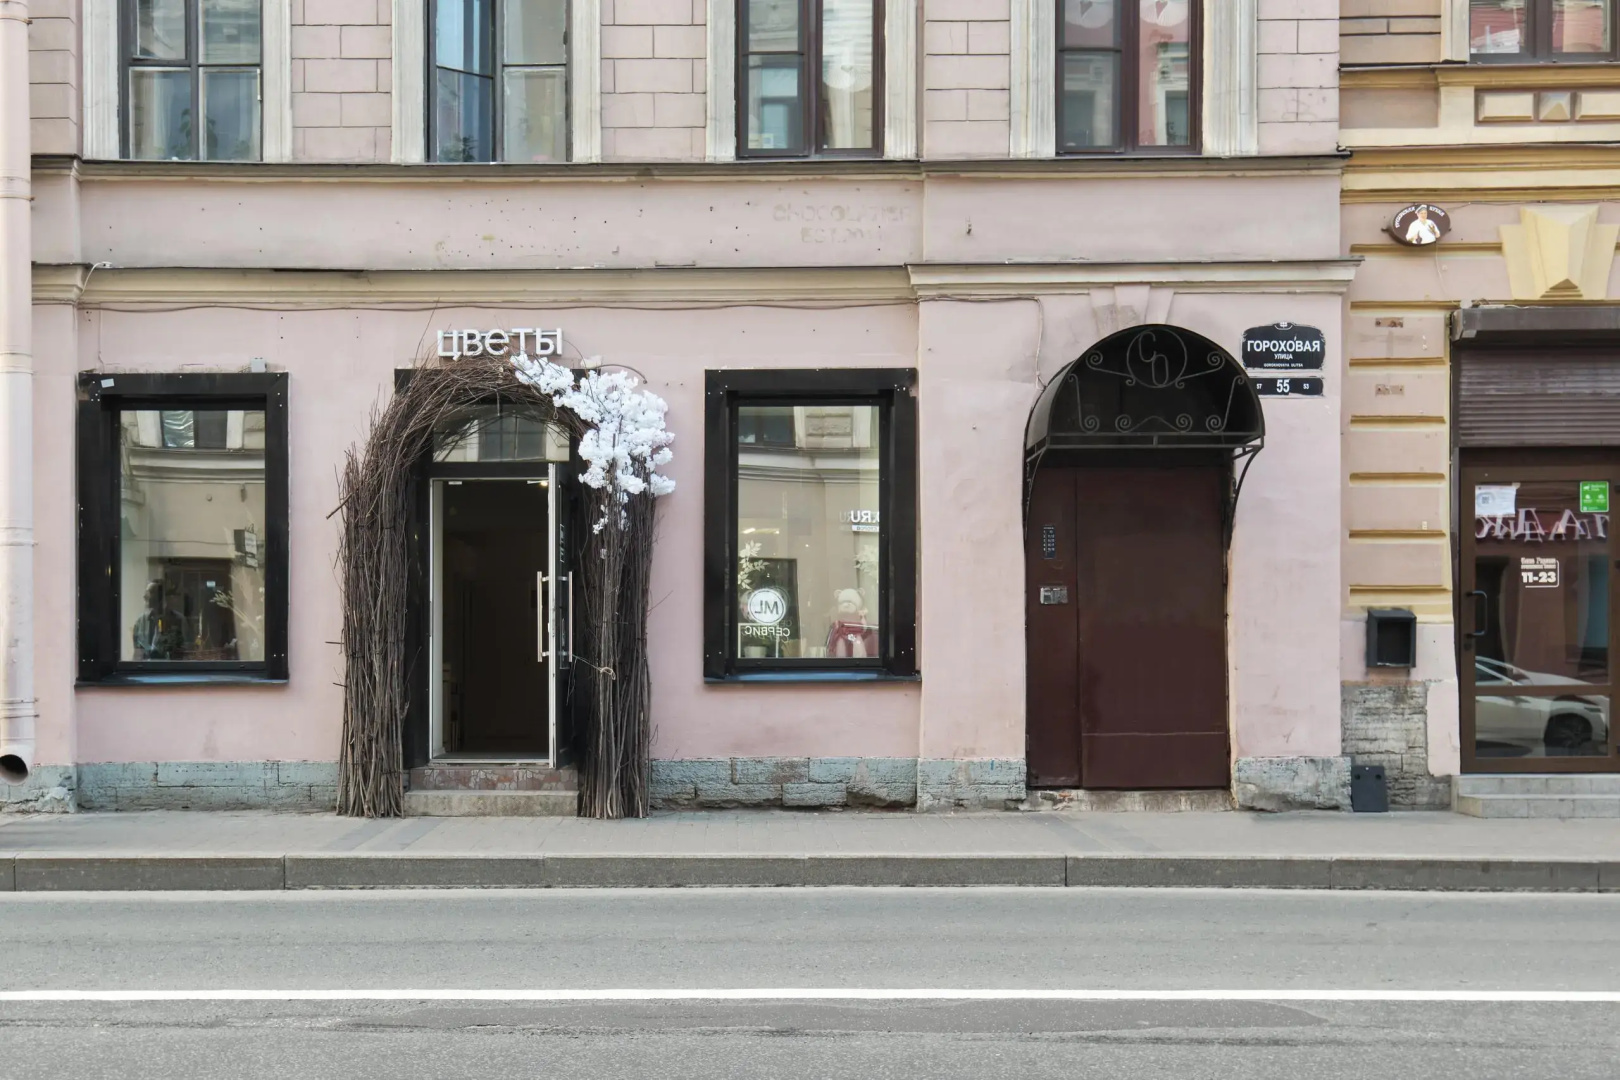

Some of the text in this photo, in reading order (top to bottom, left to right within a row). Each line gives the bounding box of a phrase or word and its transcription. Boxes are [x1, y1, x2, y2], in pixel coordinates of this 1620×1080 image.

[1247, 340, 1320, 352] ГОРОХОВАЯ
[1276, 379, 1290, 393] 55
[1521, 571, 1557, 583] 11-23
